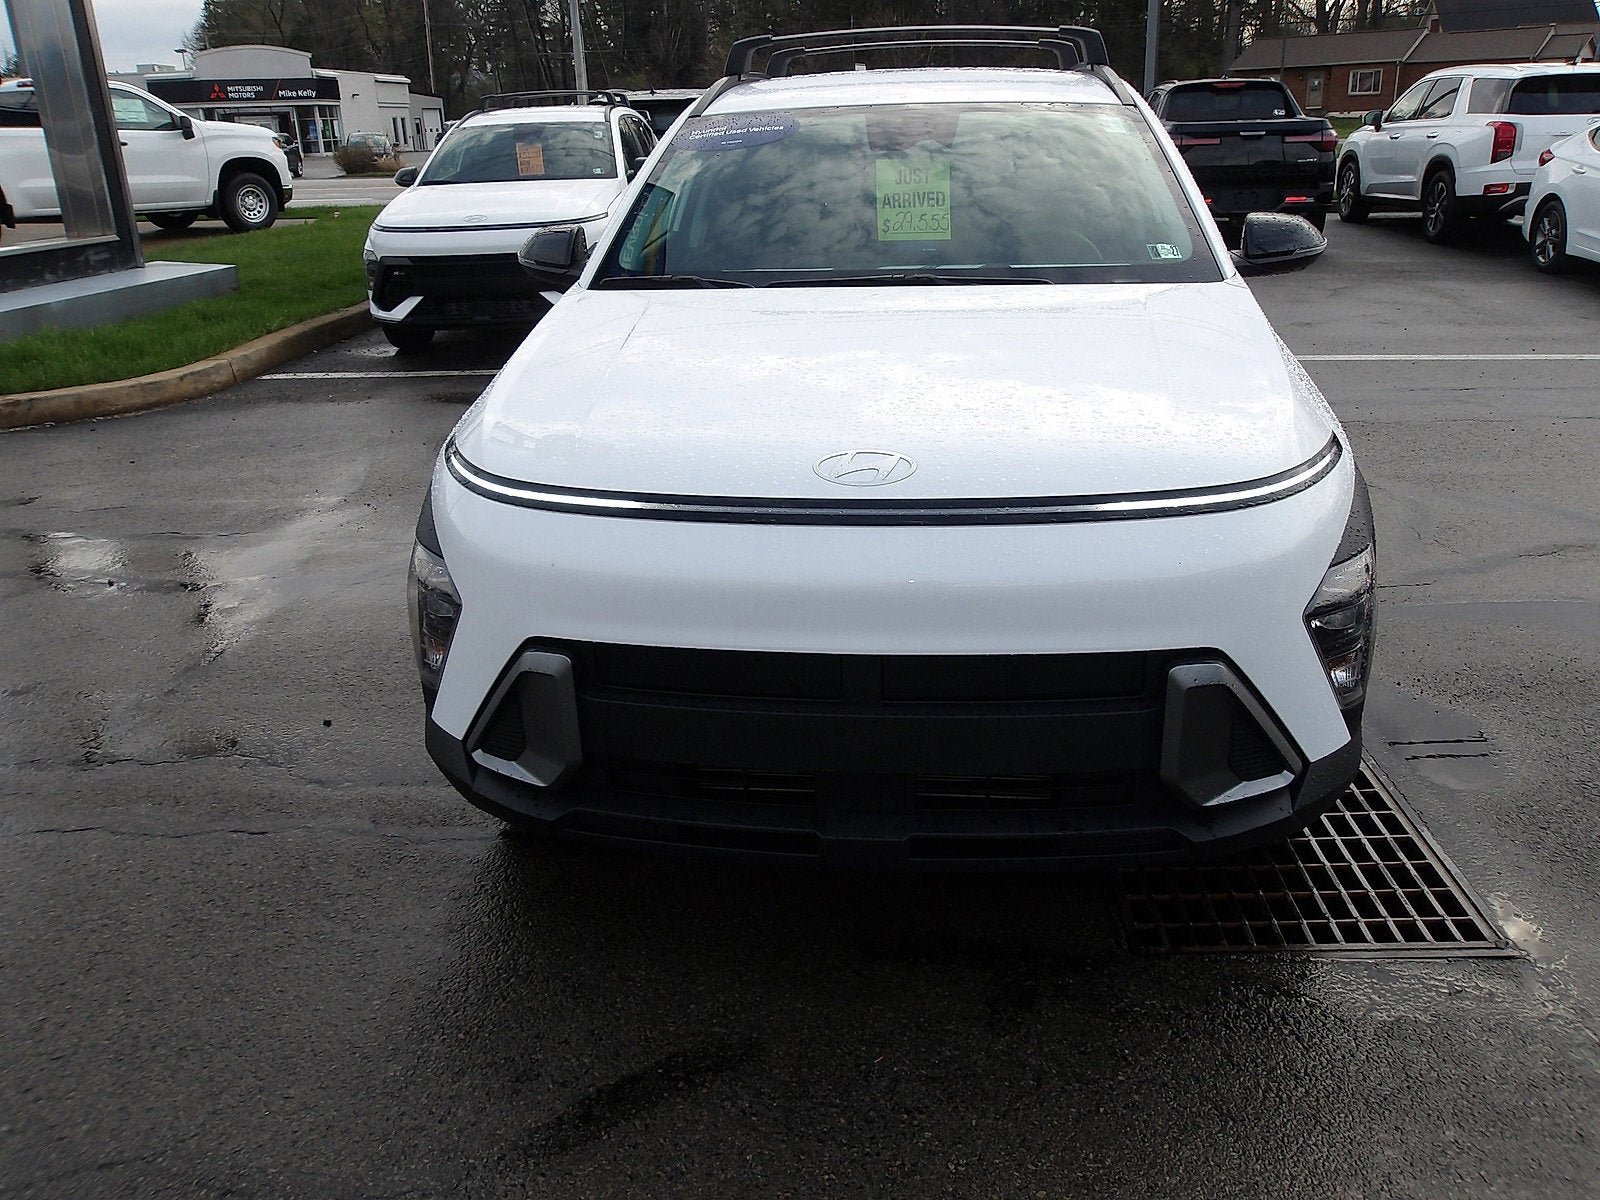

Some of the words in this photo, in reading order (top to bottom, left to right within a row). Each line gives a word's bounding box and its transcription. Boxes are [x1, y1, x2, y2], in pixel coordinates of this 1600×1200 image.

[278, 90, 297, 98] Mike
[297, 89, 317, 98] Kelly
[894, 167, 931, 186] JUST
[882, 191, 946, 209] ARRIVED
